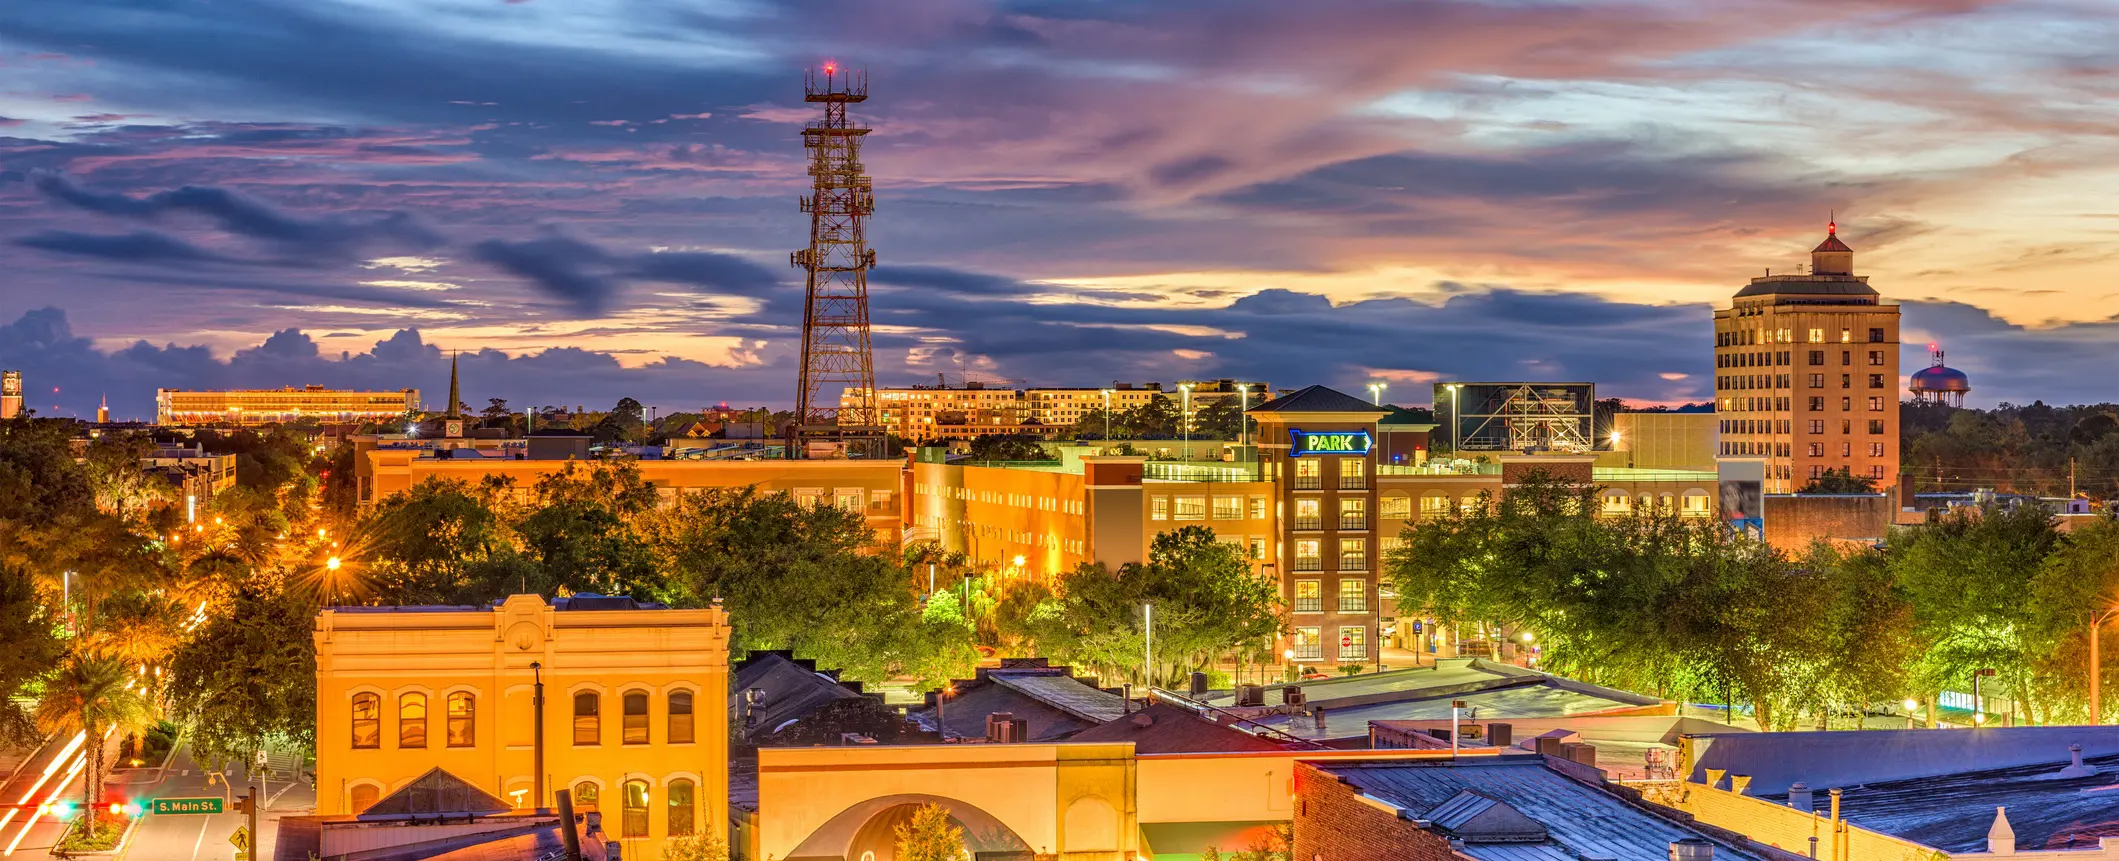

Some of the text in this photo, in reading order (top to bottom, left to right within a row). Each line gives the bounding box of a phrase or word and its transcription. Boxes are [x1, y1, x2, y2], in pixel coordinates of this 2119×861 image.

[1308, 435, 1353, 451] PARK
[160, 802, 217, 811] S. Main St.
